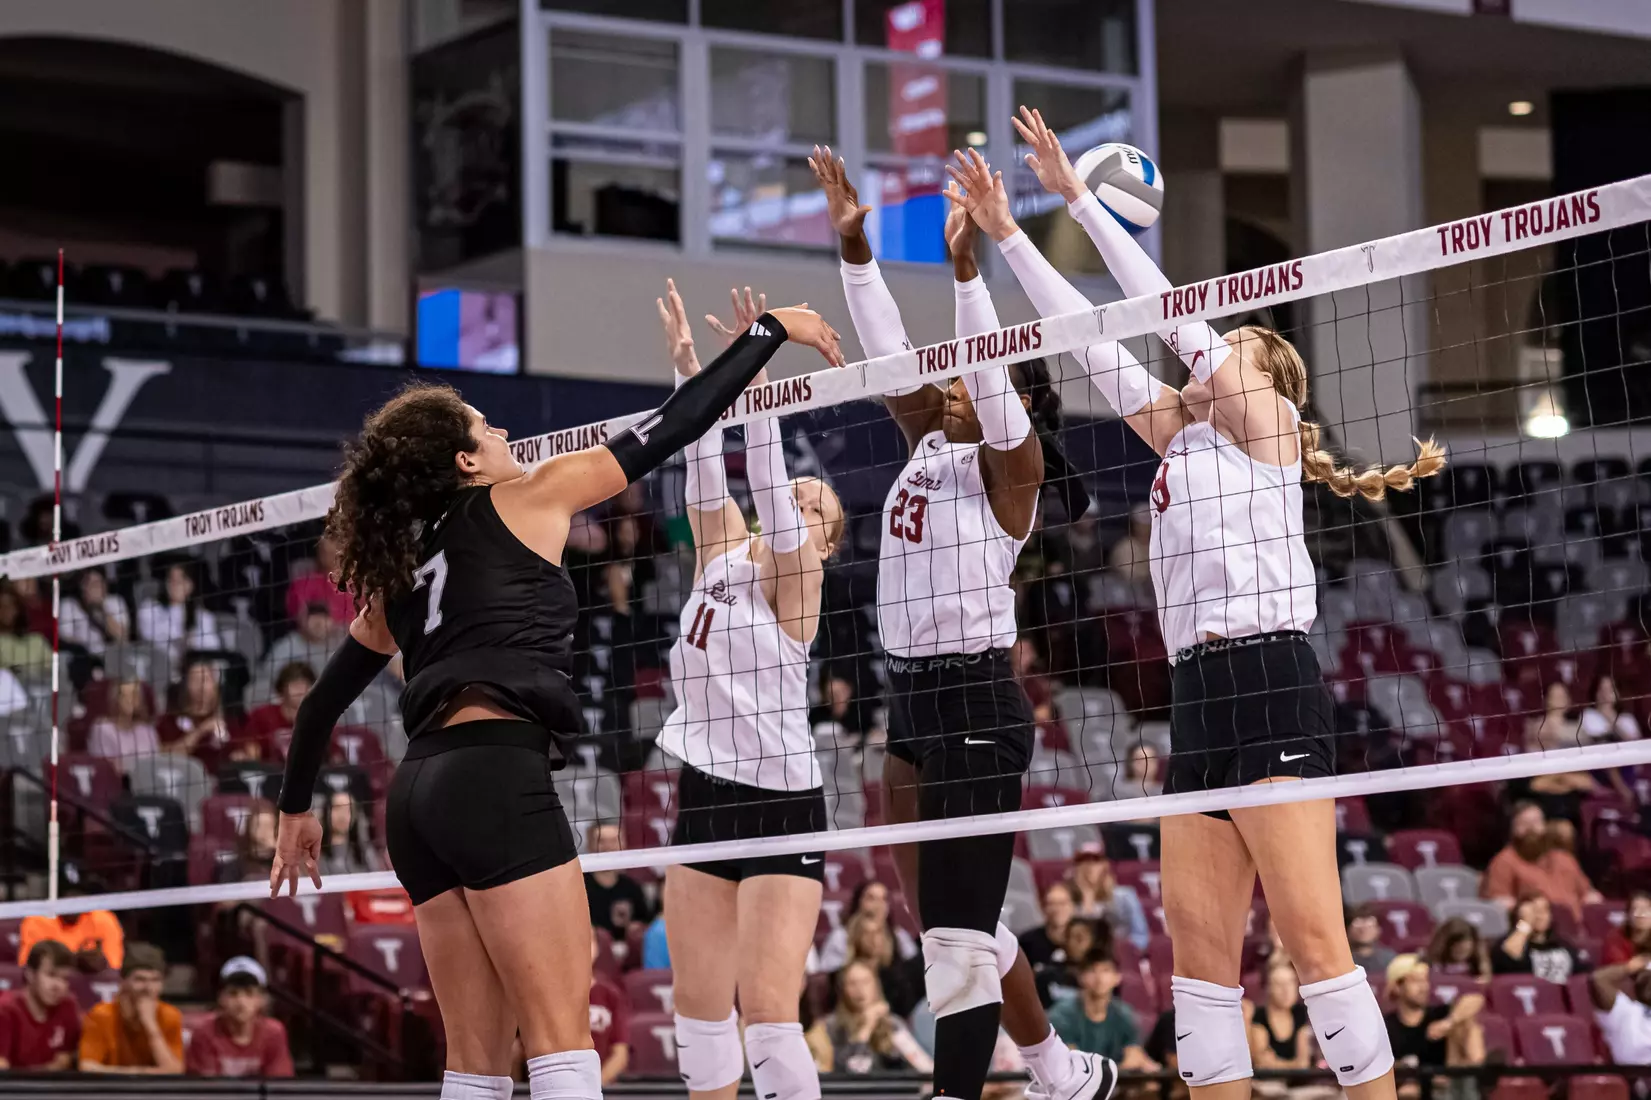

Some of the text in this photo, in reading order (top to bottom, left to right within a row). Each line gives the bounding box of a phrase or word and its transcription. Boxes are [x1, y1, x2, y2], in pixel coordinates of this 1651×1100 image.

[1437, 190, 1601, 256] TROY TROJANS
[1160, 260, 1304, 320] TROY TROJANS
[916, 321, 1042, 375] TROY TROJANS
[743, 375, 812, 414] TROJANS
[547, 422, 608, 457] TROJANS
[184, 500, 264, 538] TROY TROJANS
[889, 487, 930, 545] 23
[411, 548, 449, 636] 7
[686, 602, 716, 651] 11
[888, 657, 925, 674] NIKE
[927, 652, 982, 672] PRO
